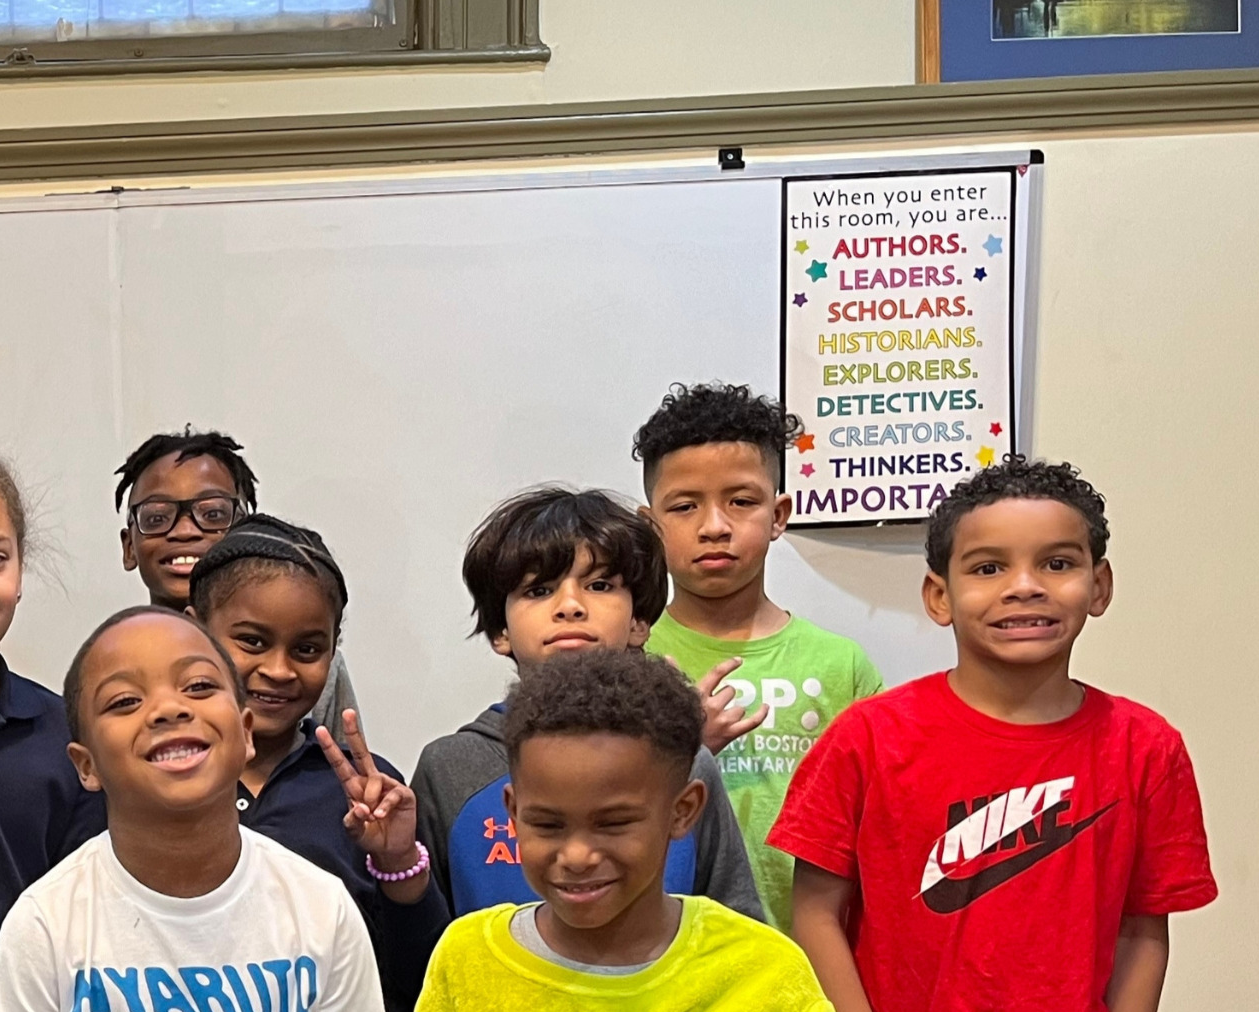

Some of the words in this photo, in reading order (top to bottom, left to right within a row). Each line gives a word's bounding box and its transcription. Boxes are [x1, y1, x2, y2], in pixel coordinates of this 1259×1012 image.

[813, 189, 875, 207] When
[884, 188, 923, 208] you
[930, 186, 988, 202] enter
[790, 212, 830, 230] this
[838, 212, 901, 229] room,
[908, 208, 947, 229] you
[956, 207, 1008, 221] are...
[832, 233, 967, 260] AUTHORS.
[839, 265, 963, 291] LEADERS.
[827, 296, 973, 323] SCHOLARS.
[818, 327, 983, 355] HISTORIANS.
[822, 358, 979, 386] EXPLORERS.
[816, 389, 984, 417] DETECTIVES.
[829, 421, 972, 448] CREATORS.
[829, 452, 971, 478] THINKERS.
[795, 483, 947, 515] IMPORTA
[755, 734, 818, 753] BOSTO
[941, 776, 1075, 864] NIKE
